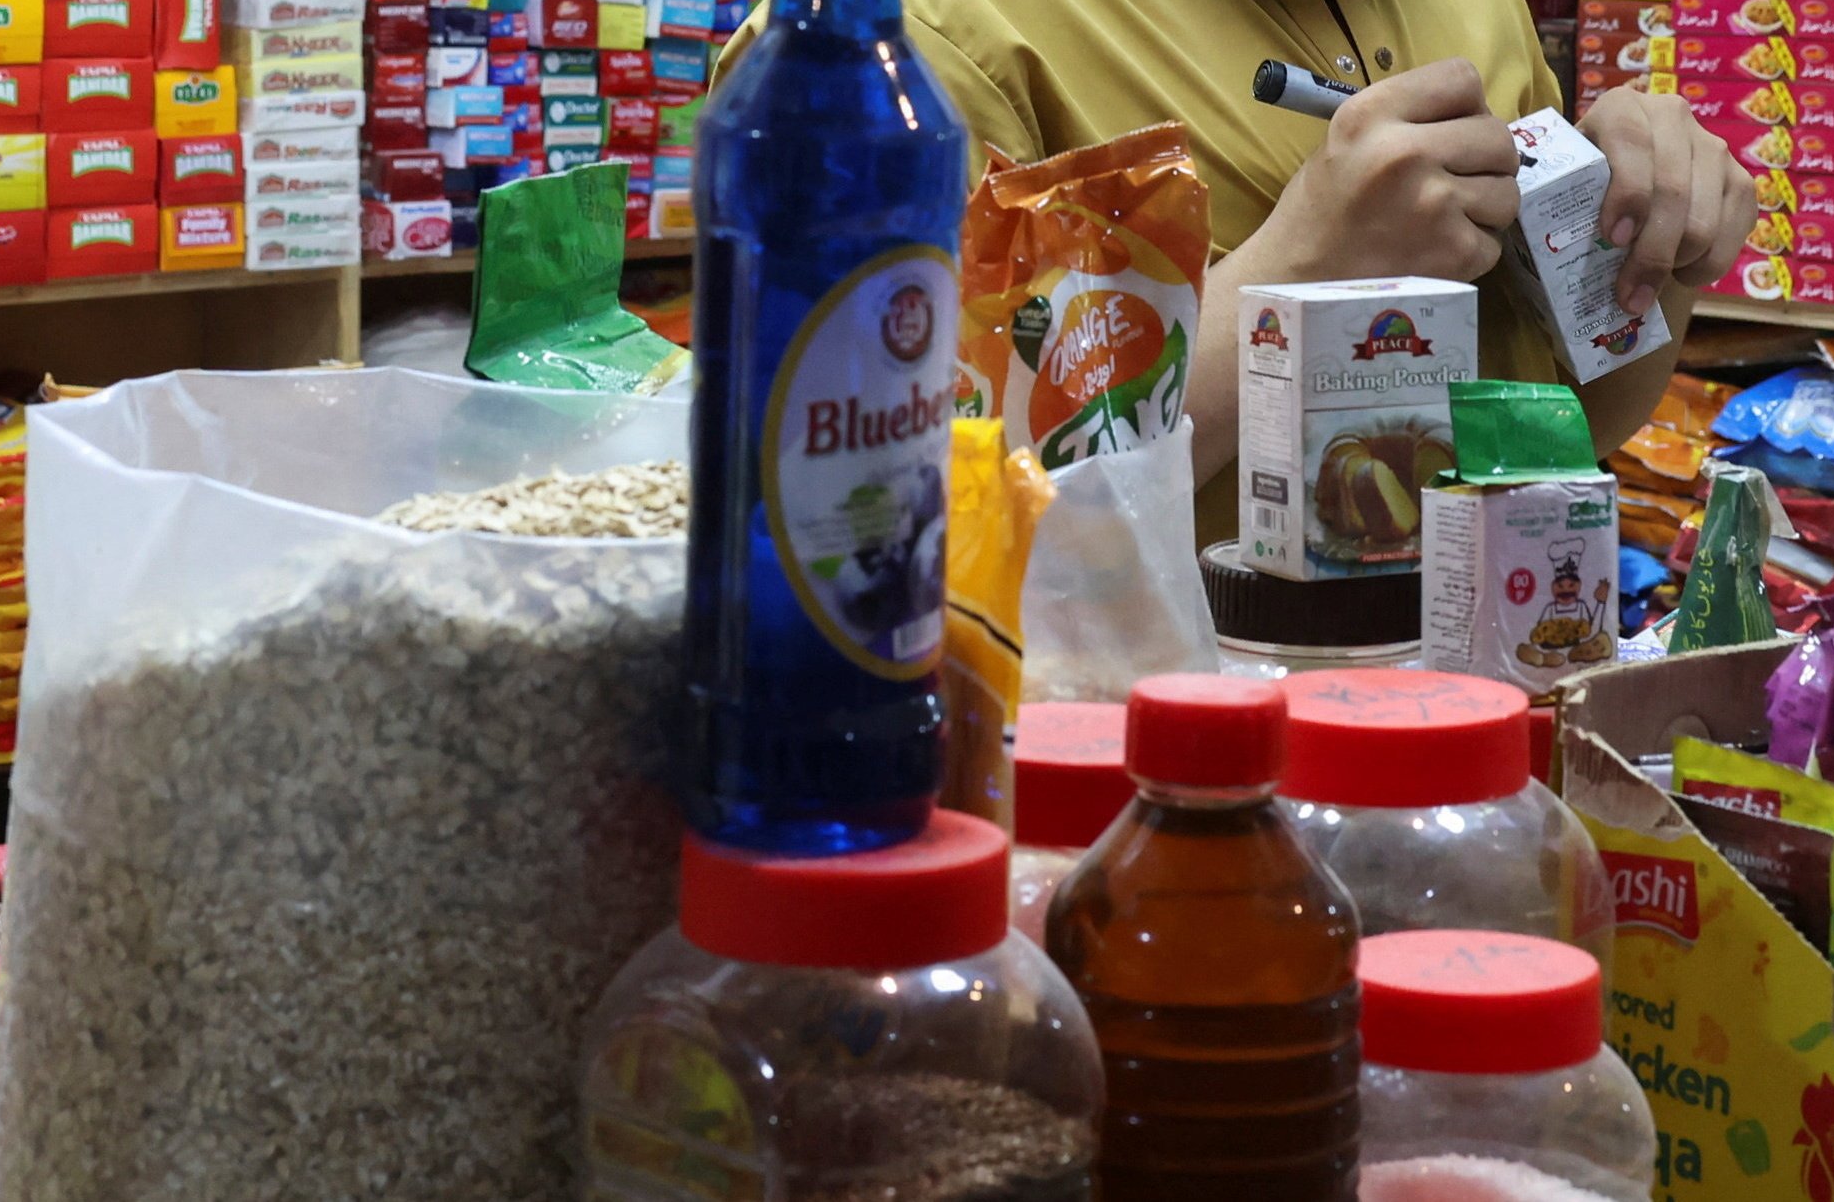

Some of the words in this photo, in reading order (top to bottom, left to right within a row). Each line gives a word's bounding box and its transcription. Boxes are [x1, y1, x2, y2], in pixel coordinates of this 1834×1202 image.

[1372, 336, 1412, 353] PEACE
[1314, 371, 1388, 394] Baking
[1392, 367, 1470, 387] Powder
